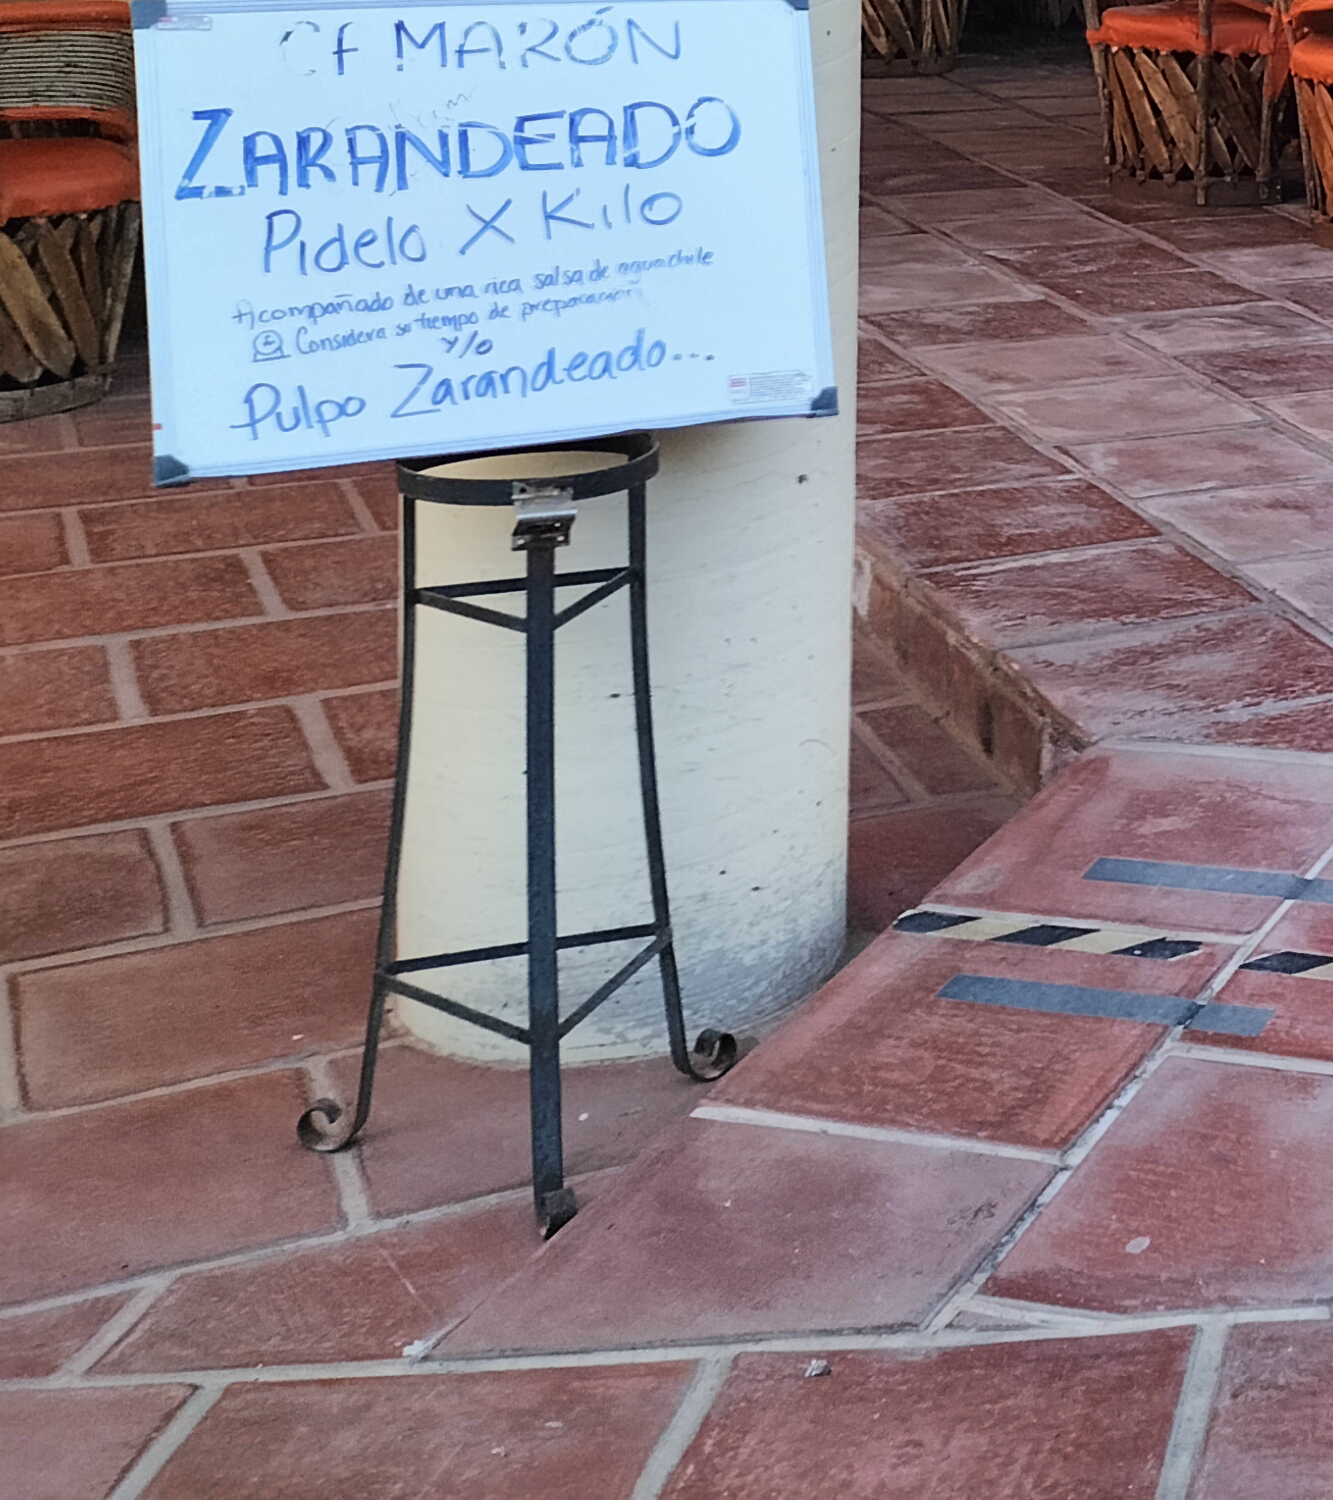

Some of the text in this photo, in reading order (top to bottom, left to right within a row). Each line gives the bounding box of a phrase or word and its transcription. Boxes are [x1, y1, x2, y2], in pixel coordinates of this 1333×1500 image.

[174, 96, 742, 200] ZARANDEADO
[263, 209, 428, 275] Pidelo
[541, 184, 683, 240] Kilo
[231, 291, 395, 330] Acompañado
[403, 283, 430, 306] de
[435, 284, 479, 300] una
[484, 277, 524, 295] rica
[534, 265, 584, 290] salsa
[588, 258, 610, 282] de
[295, 326, 387, 355] Considera
[413, 312, 479, 332] tiempo
[488, 303, 511, 321] de
[230, 382, 366, 441] Pulpo
